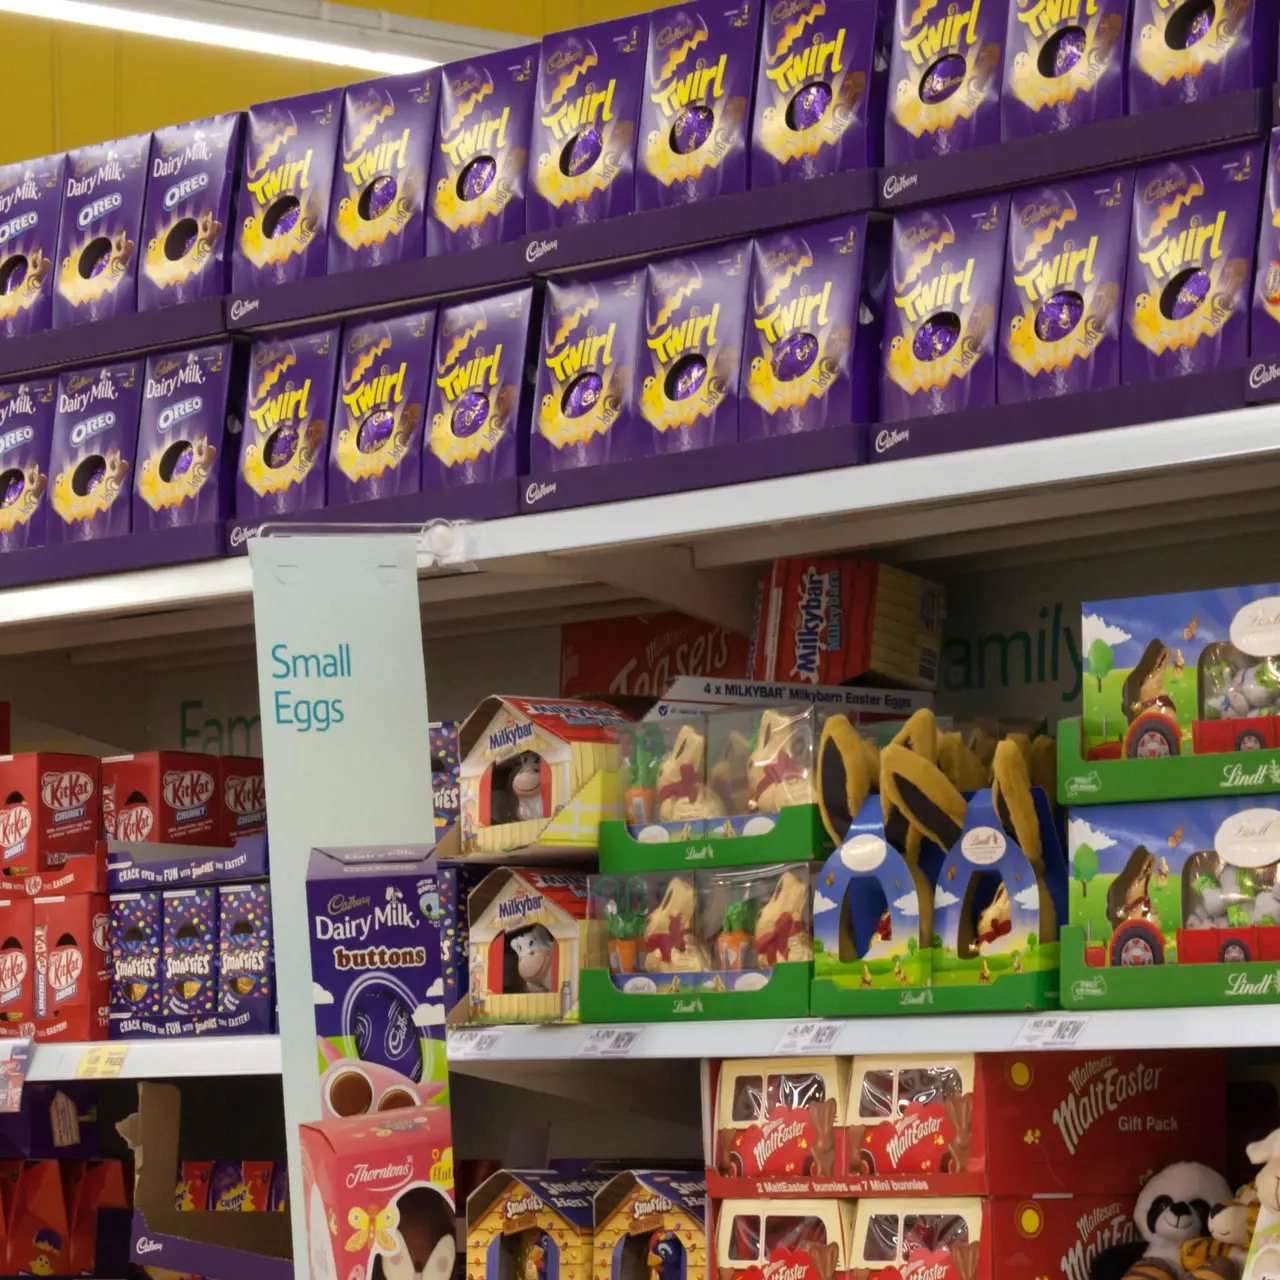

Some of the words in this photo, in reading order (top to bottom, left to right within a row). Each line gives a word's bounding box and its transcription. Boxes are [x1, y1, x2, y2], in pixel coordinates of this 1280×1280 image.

[767, 28, 844, 91] Twirl
[164, 174, 208, 208] OREO
[76, 194, 121, 228] OREO
[754, 282, 831, 344] Twirl
[272, 644, 352, 678] Small
[704, 685, 711, 694] 4
[790, 689, 842, 703] Milkybarn
[846, 693, 882, 705] Easter
[885, 695, 911, 708] Eggs
[275, 692, 344, 731] Eggs
[489, 721, 533, 750] Milkybar
[1221, 762, 1268, 788] Lindt
[120, 869, 139, 882] CRACK
[141, 870, 154, 880] OPEN
[164, 868, 178, 881] FUN
[316, 914, 369, 942] Dairy
[335, 947, 425, 969] buttons
[1119, 1115, 1142, 1131] Gift
[1149, 1115, 1177, 1131] Pack
[346, 1160, 413, 1187] Thorntons
[757, 1181, 764, 1191] 2
[814, 1181, 847, 1193] bunnies
[850, 1183, 859, 1191] and
[863, 1181, 868, 1191] 7
[871, 1181, 888, 1191] Mini
[892, 1179, 928, 1191] bunnies
